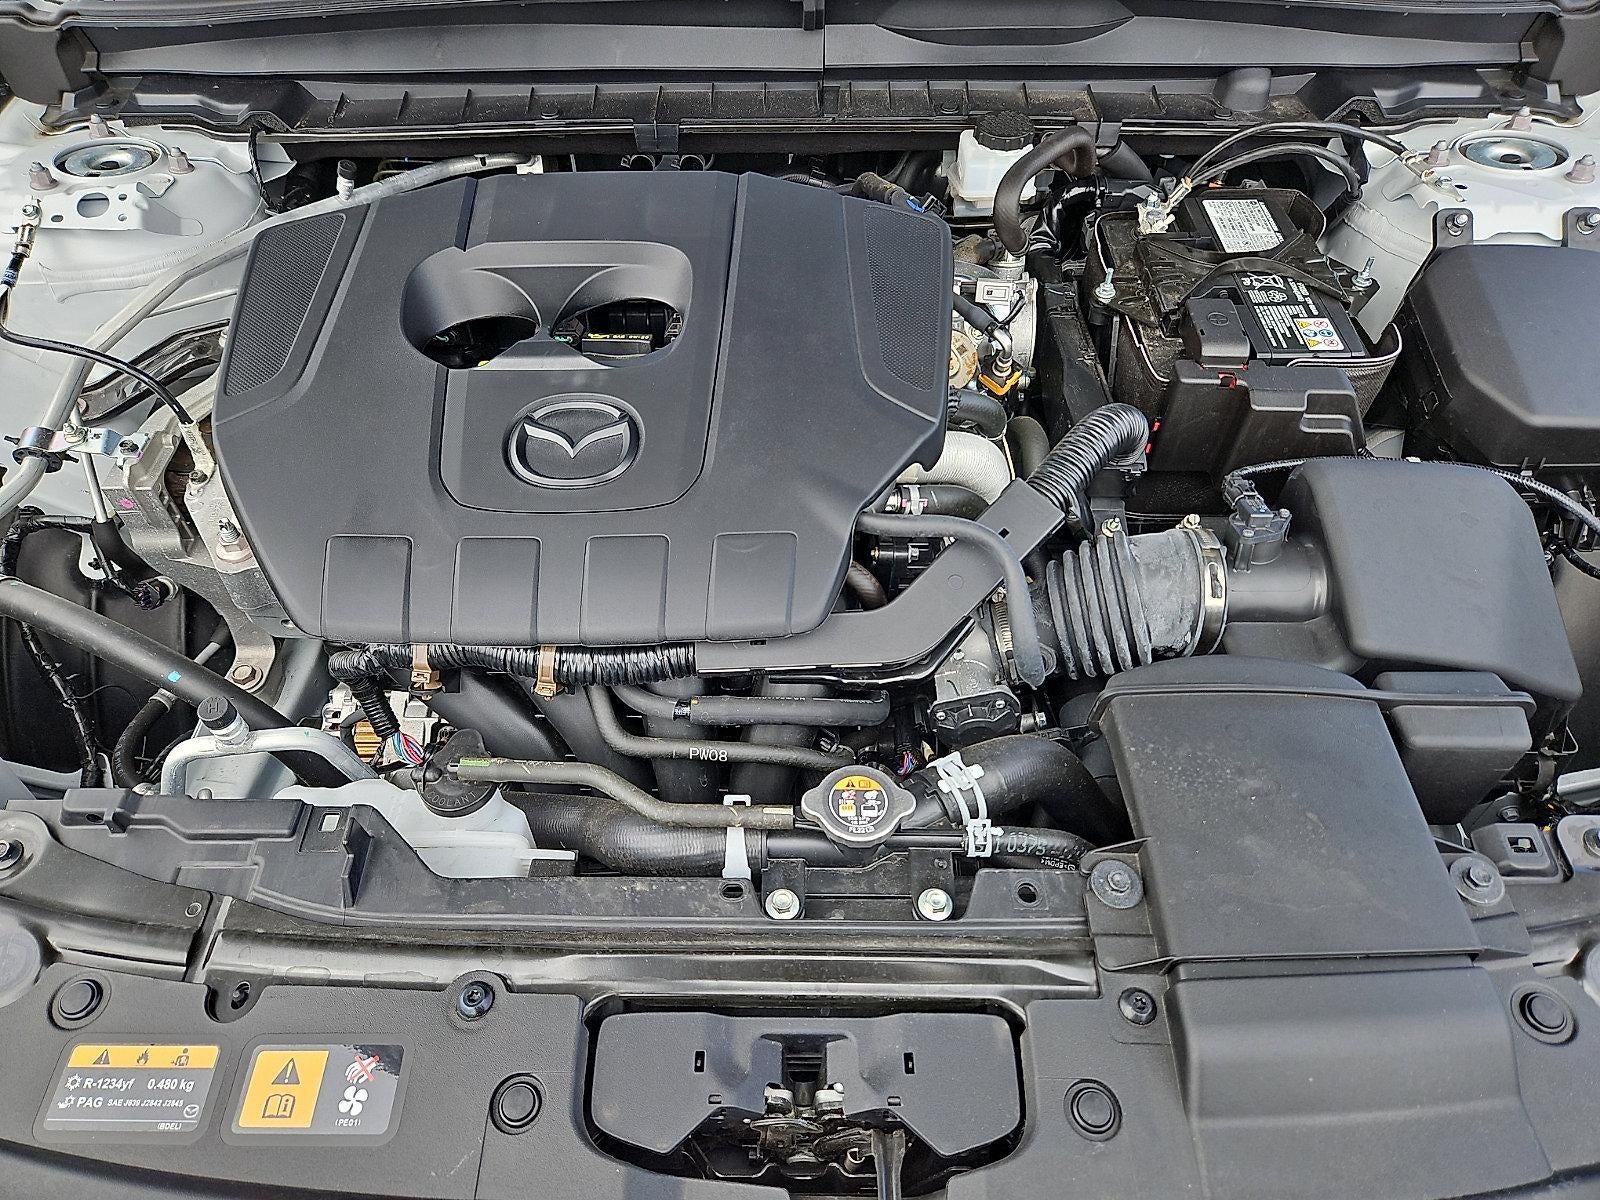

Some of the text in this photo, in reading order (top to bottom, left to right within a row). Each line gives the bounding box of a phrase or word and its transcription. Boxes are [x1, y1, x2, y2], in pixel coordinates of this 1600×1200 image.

[689, 747, 728, 762] PW08
[426, 790, 476, 807] COOLANT
[82, 1078, 195, 1092] R-1234yf 0.480 kg
[76, 1096, 103, 1108] PAG
[335, 1118, 361, 1127] (PE01)
